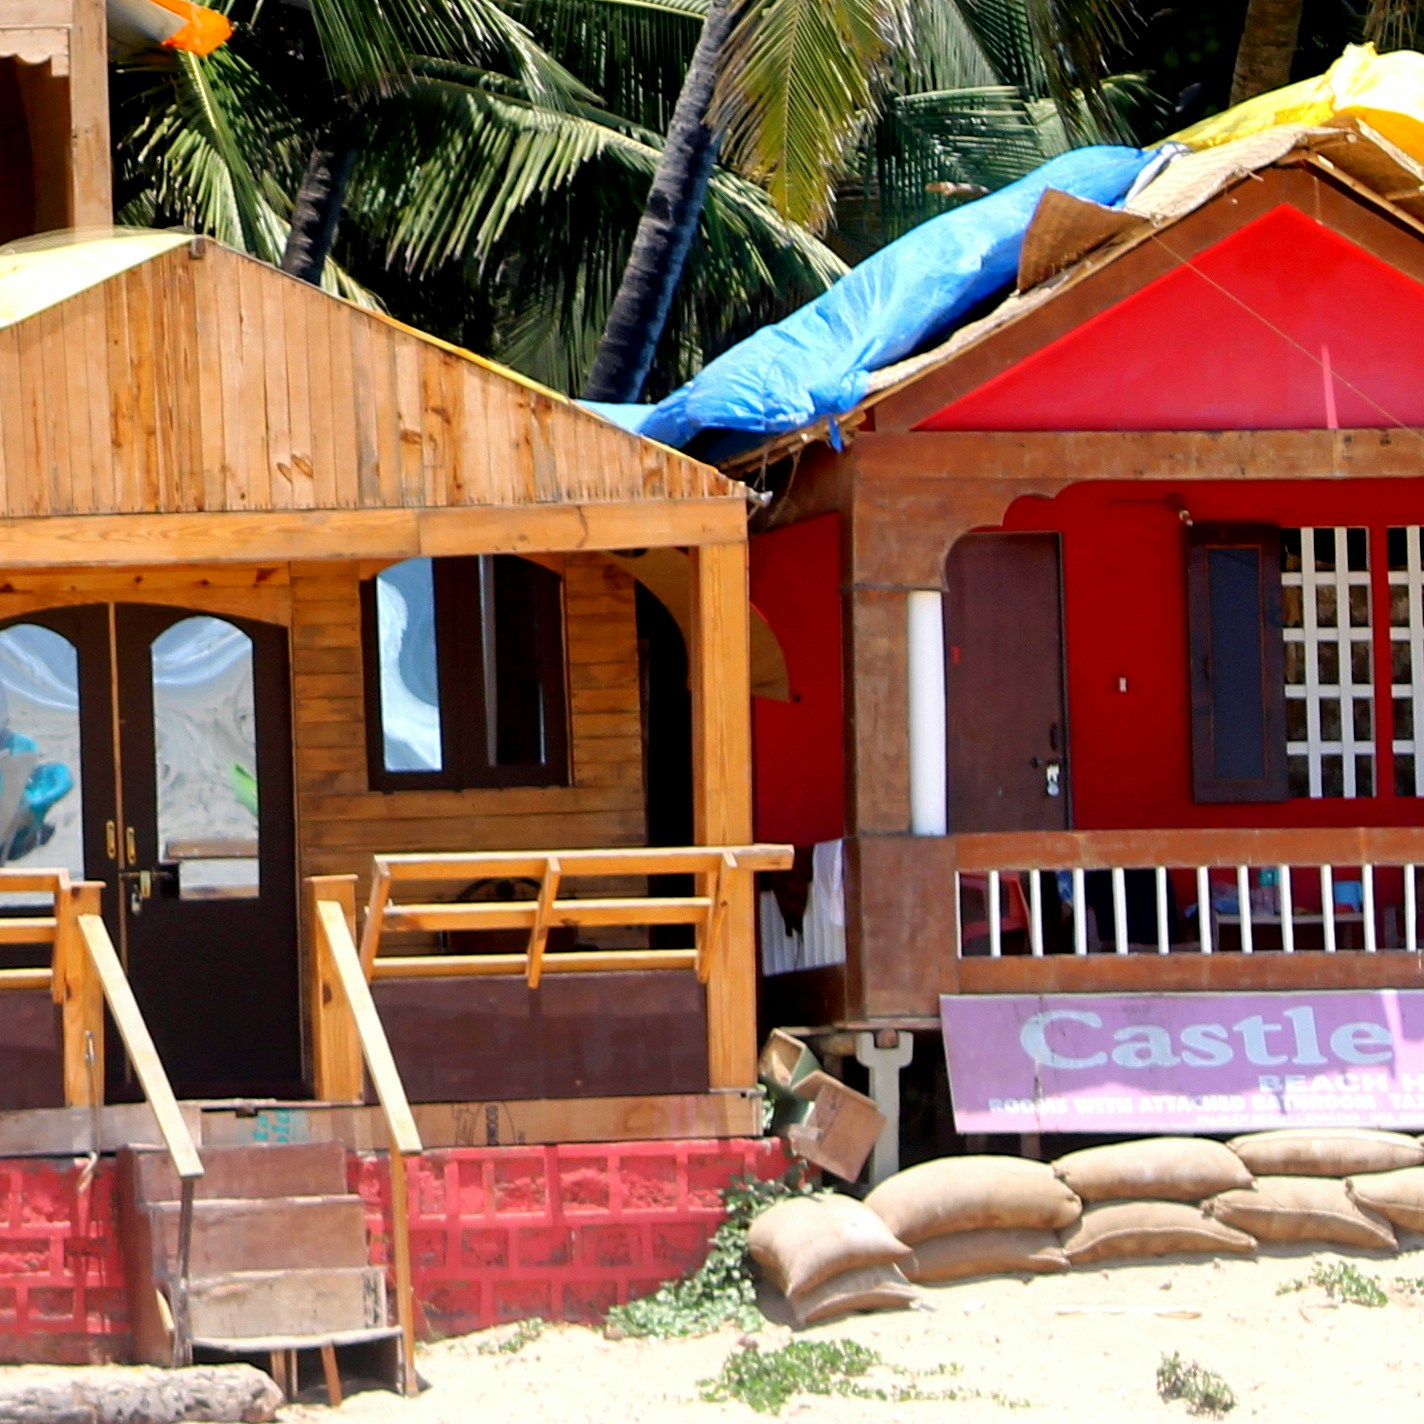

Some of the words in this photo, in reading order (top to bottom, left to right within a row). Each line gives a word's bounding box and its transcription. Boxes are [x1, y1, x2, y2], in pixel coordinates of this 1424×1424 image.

[1019, 1005, 1394, 1069] Castle
[1258, 1072, 1389, 1093] BEACH
[988, 1097, 1068, 1115] ROOMS
[1071, 1096, 1134, 1114] WITH
[1138, 1094, 1246, 1113] ATTACHED
